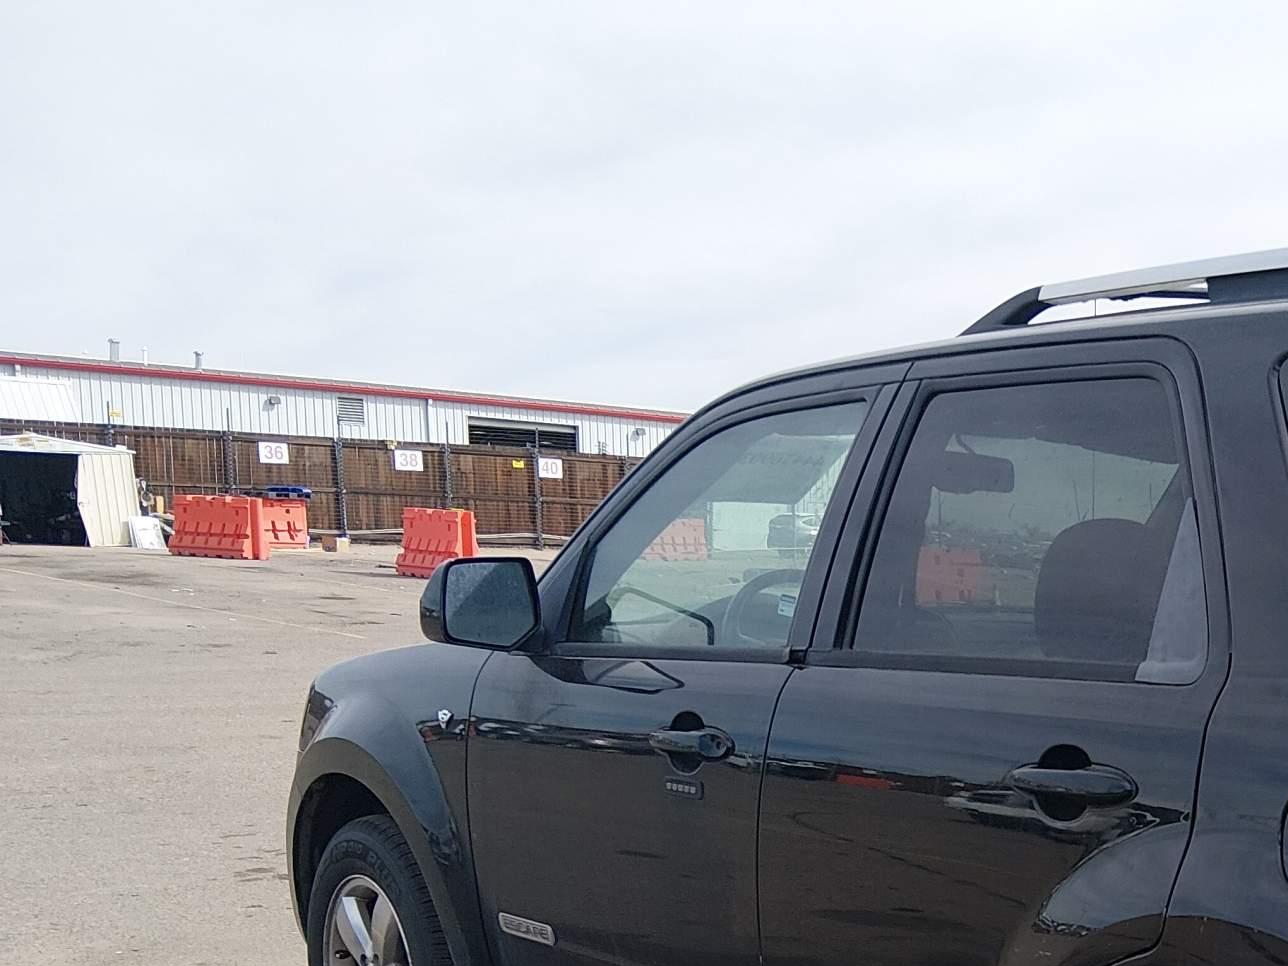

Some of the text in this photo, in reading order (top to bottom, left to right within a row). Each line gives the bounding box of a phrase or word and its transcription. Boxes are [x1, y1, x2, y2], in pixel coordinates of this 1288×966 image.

[263, 445, 284, 460] 36
[399, 453, 418, 467] 38
[541, 461, 558, 475] 40
